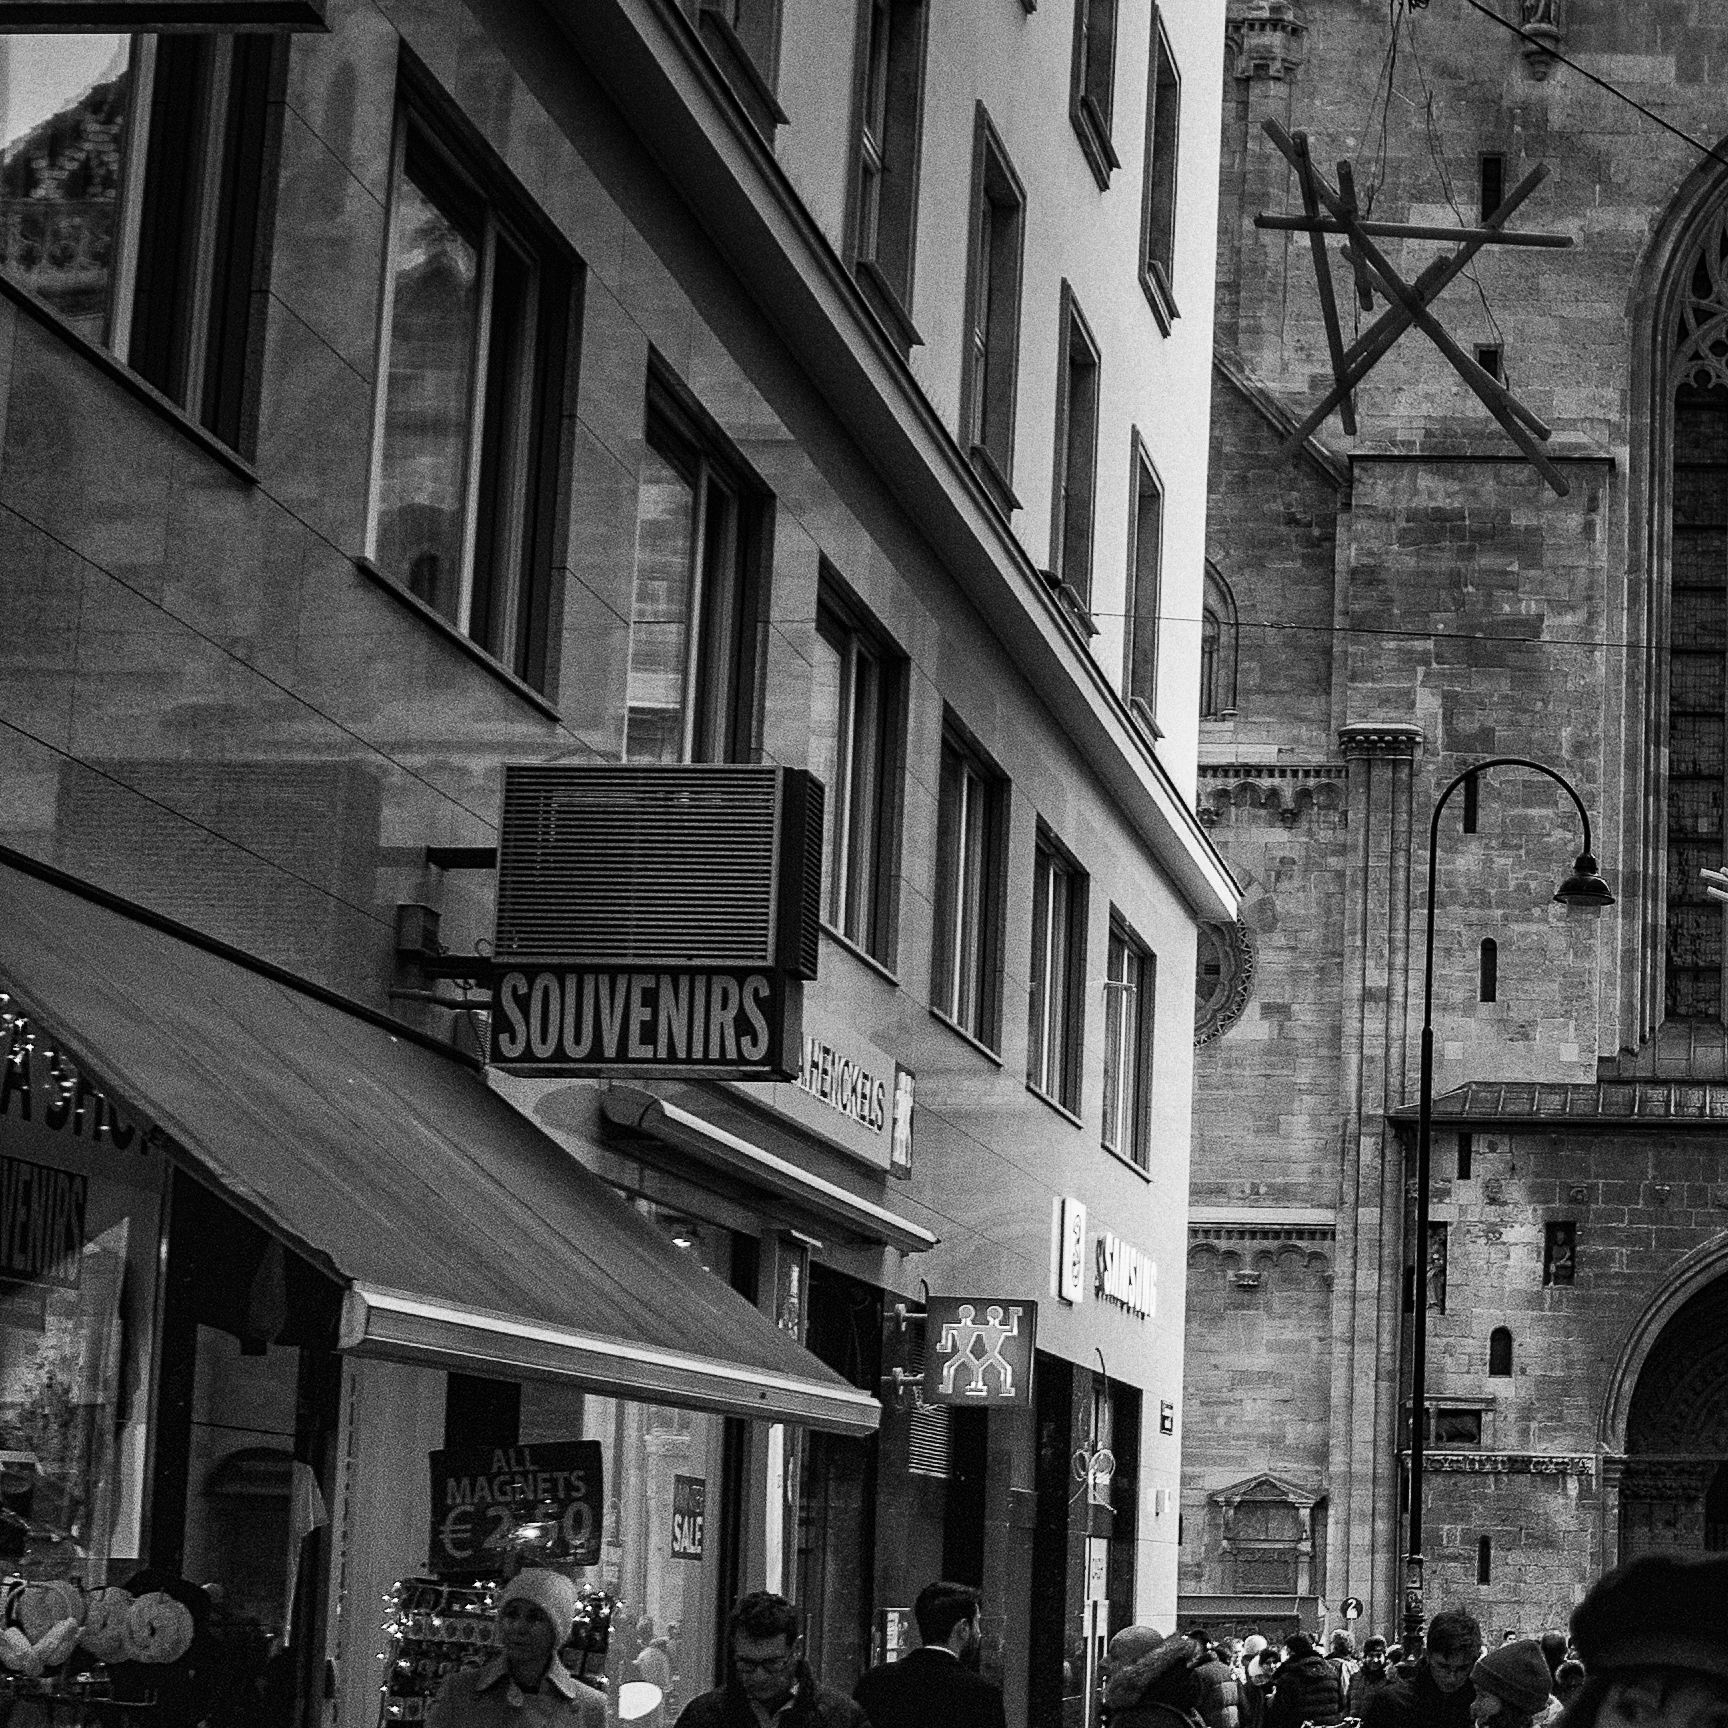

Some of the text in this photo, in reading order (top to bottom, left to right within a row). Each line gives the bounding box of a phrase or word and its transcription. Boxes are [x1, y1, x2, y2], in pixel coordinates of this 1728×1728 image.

[498, 971, 771, 1061] SOUVENIRS
[490, 1446, 540, 1473] ALL
[445, 1469, 588, 1506] MAGNETS
[438, 1500, 594, 1559] €250
[673, 1513, 704, 1553] SALE
